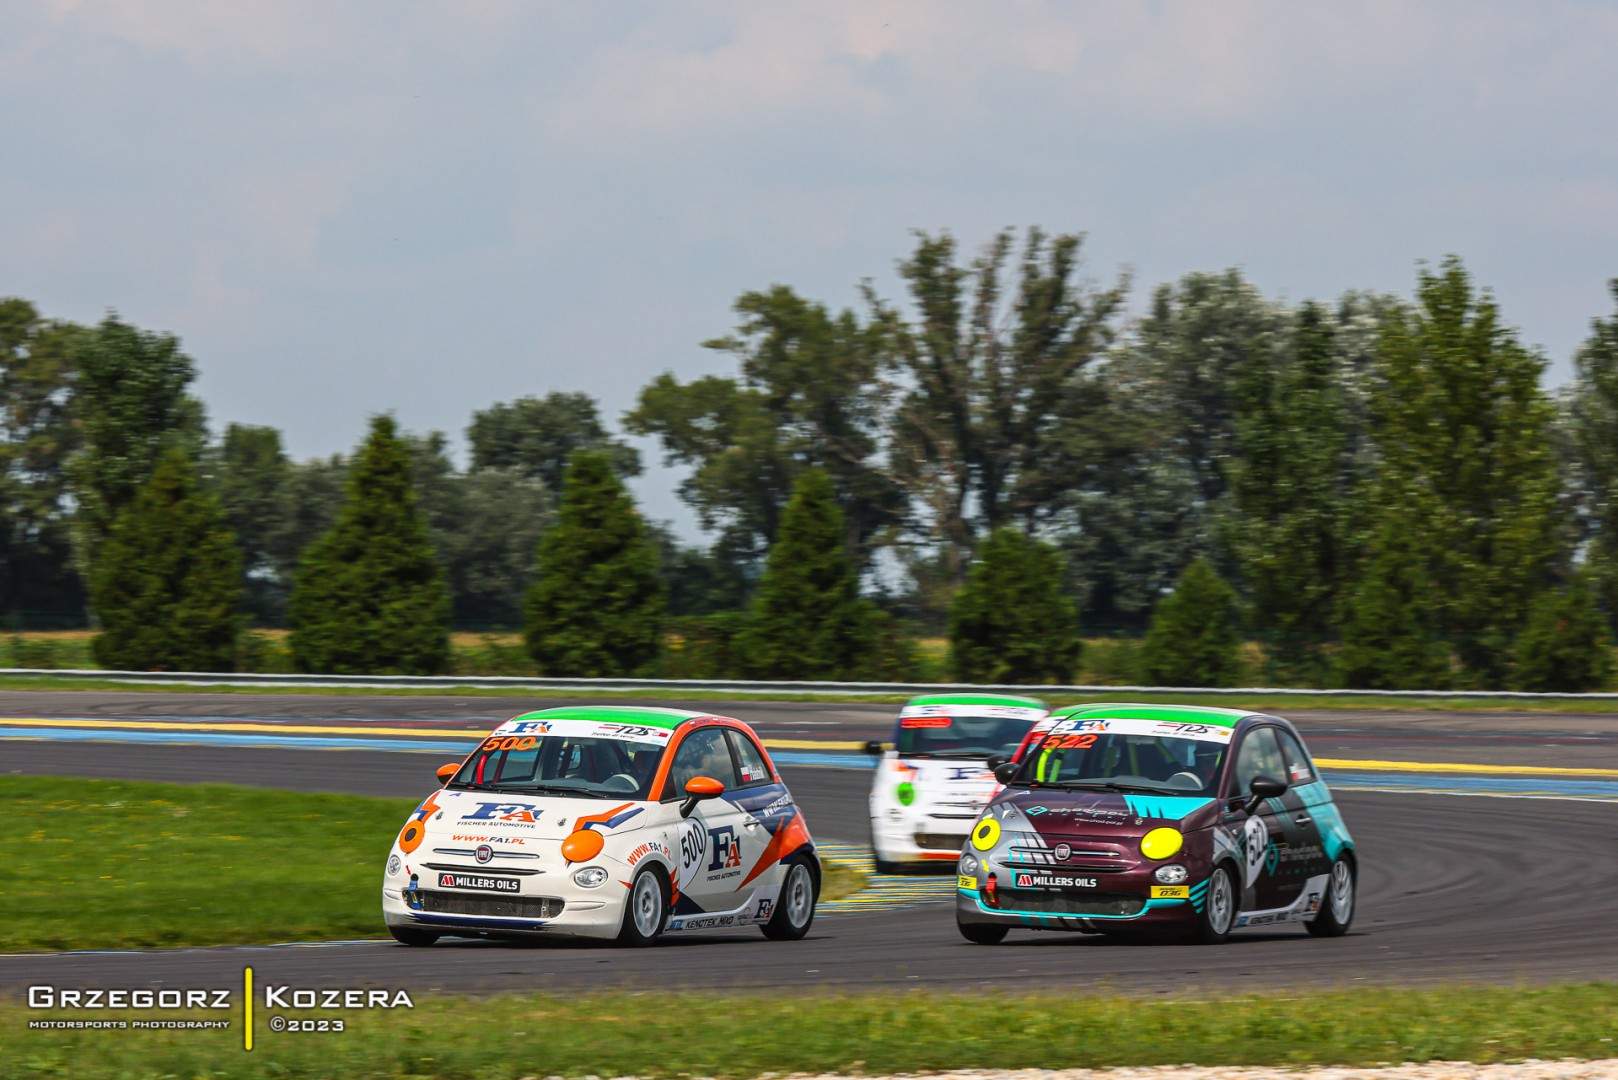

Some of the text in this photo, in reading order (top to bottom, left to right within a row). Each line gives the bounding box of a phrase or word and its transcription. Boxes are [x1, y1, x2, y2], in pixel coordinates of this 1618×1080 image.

[482, 736, 537, 751] 500
[1042, 733, 1098, 749] 522
[488, 821, 536, 829] AUTOMOTIVE
[452, 835, 525, 845] WWW.FA1.PL
[681, 823, 704, 869] 500
[456, 877, 495, 888] MILLERS
[496, 880, 518, 890] OILS
[1033, 876, 1074, 886] MILLERS
[1075, 877, 1097, 888] OILS
